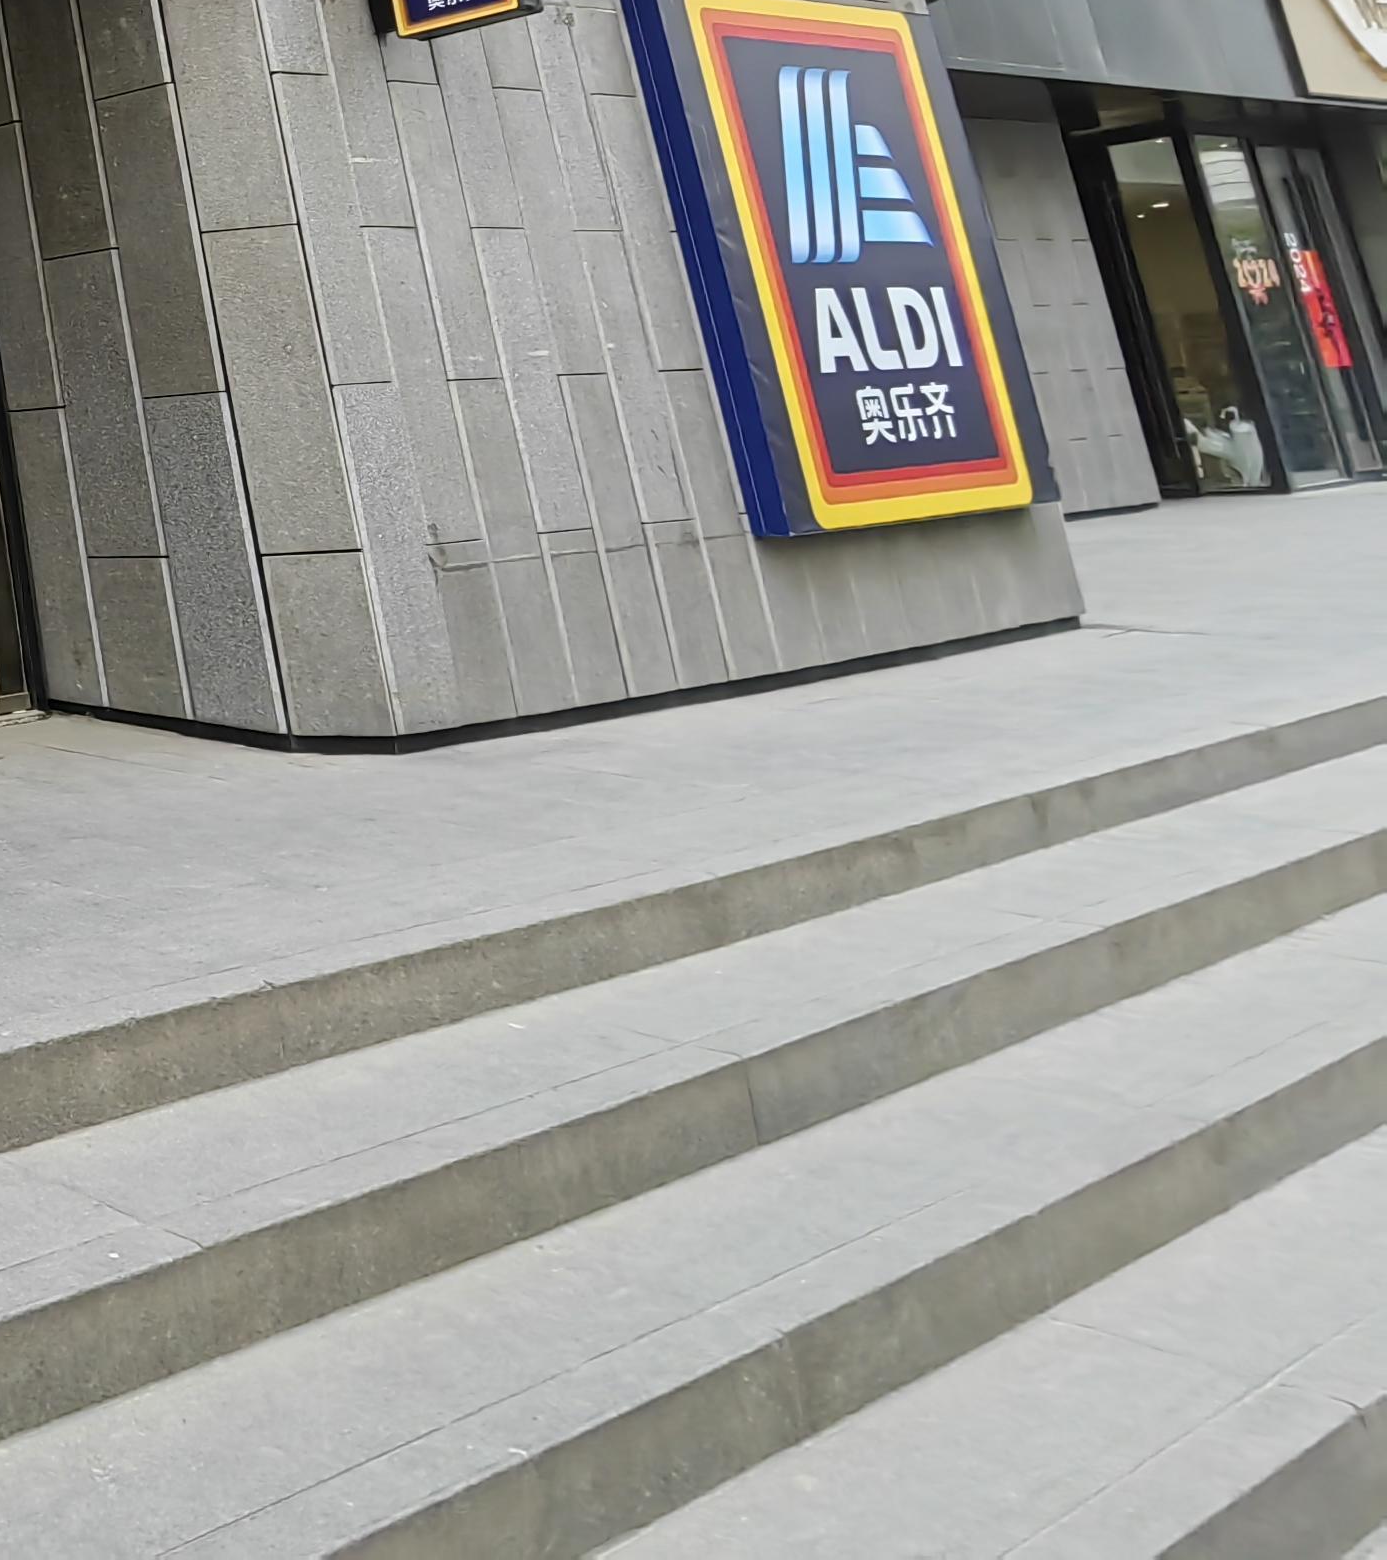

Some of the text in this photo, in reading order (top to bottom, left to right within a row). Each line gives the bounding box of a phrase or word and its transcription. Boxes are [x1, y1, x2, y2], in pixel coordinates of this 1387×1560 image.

[814, 286, 963, 373] ALDI
[854, 382, 958, 445] 奥乐齐
